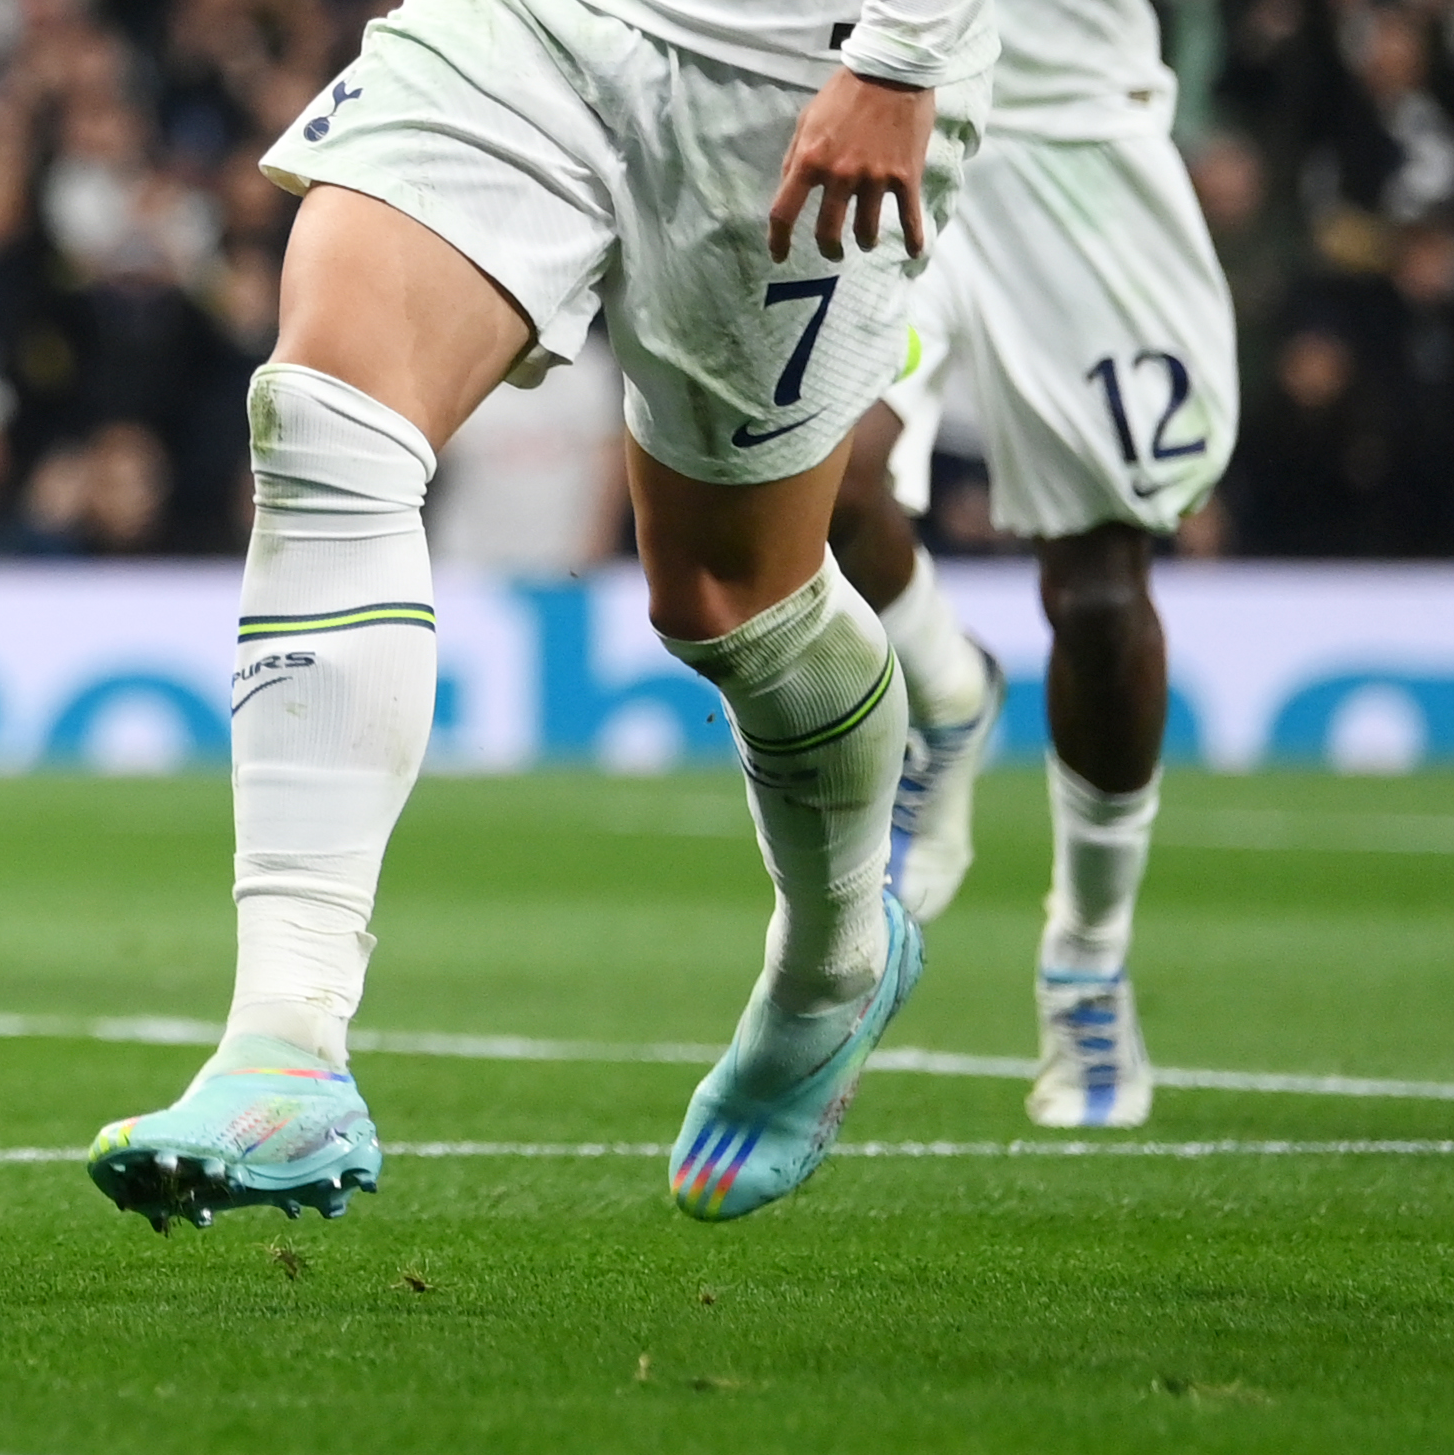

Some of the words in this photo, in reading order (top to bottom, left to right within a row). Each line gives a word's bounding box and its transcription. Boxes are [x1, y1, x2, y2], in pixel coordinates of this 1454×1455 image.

[764, 274, 840, 406] 7
[1086, 350, 1207, 463] 12
[231, 651, 316, 688] PURS
